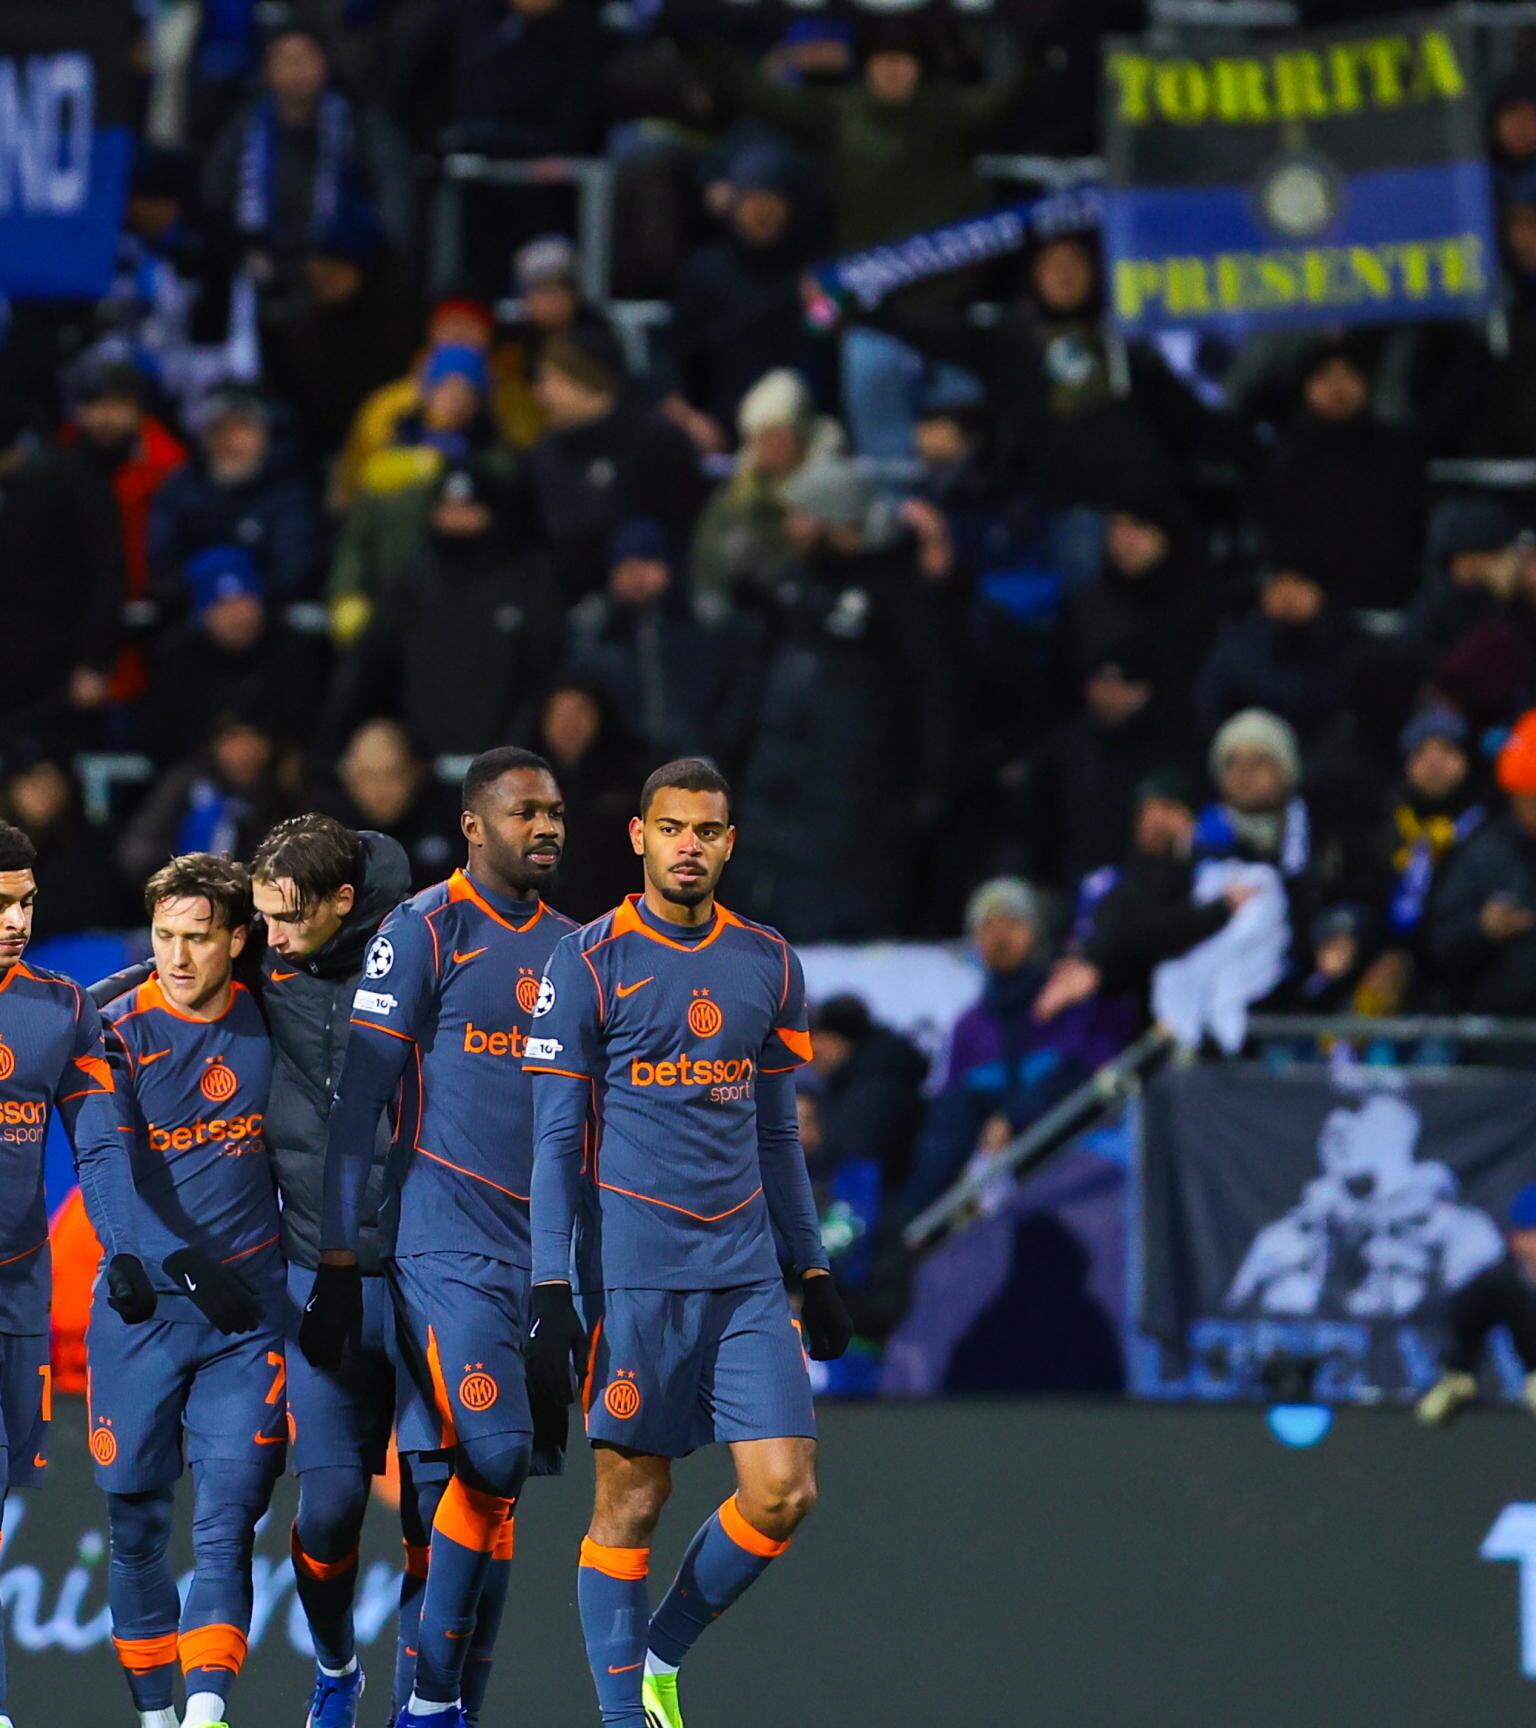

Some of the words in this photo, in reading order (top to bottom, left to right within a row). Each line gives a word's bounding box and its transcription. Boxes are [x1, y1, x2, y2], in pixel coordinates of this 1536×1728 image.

[1107, 30, 1461, 124] TORRITA
[1115, 233, 1484, 320] PRESENTE
[631, 1053, 753, 1086] betsson
[147, 1113, 265, 1151] betsso
